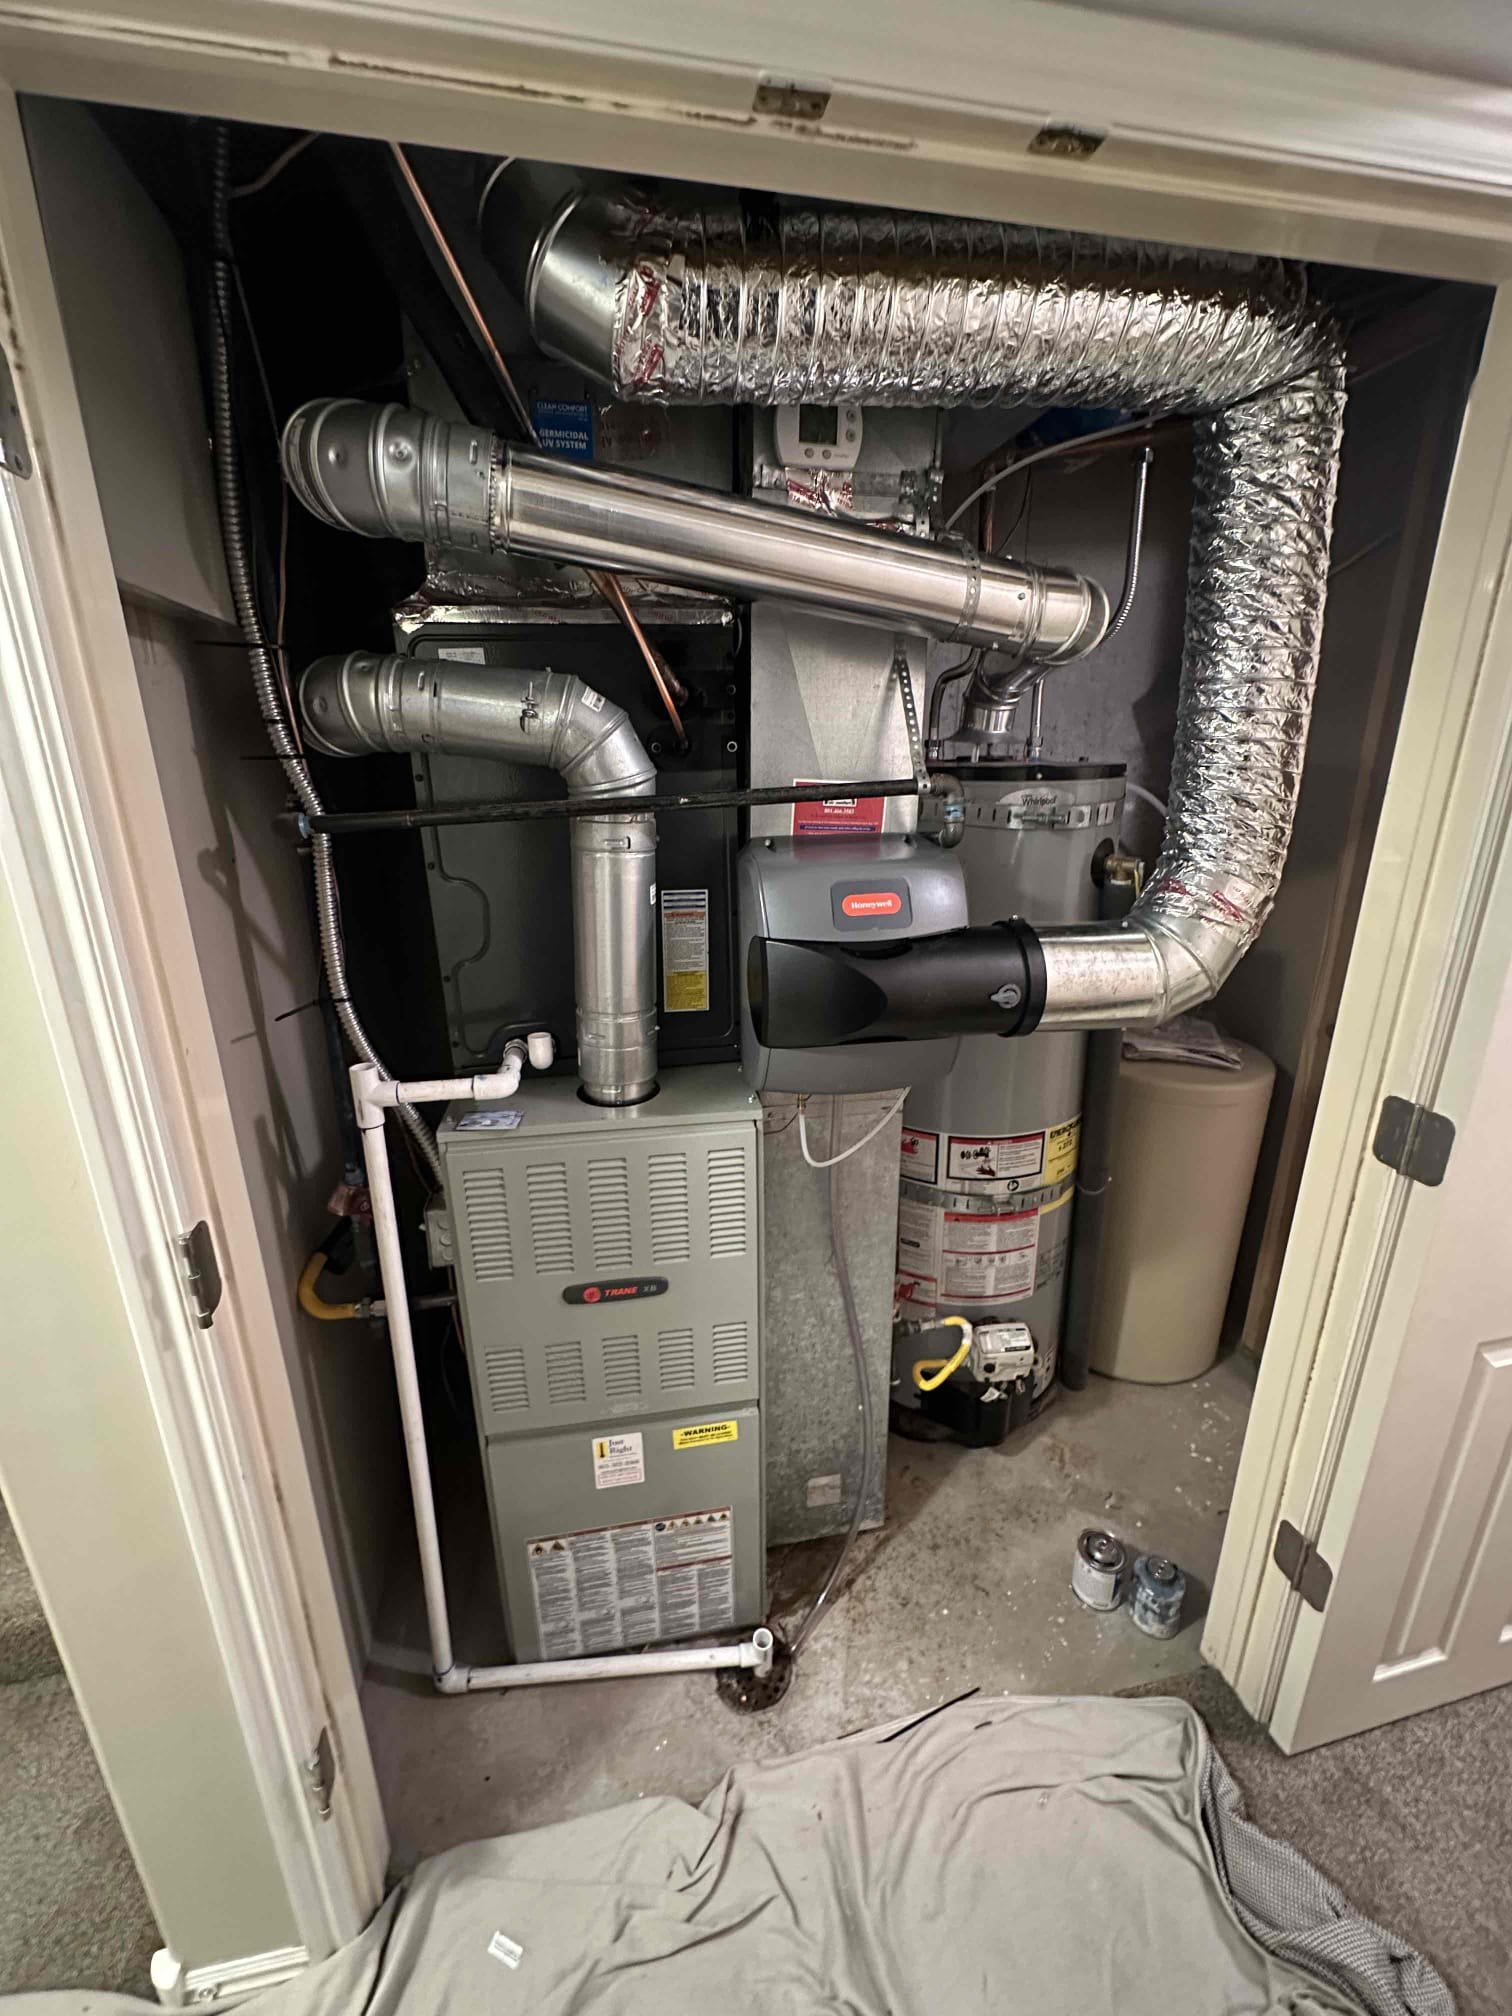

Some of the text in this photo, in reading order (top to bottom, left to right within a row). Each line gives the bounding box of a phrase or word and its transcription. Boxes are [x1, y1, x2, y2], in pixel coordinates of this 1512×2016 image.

[537, 402, 588, 412] CLEAN COMFORT
[539, 428, 589, 440] GERMICIDAL
[542, 439, 587, 449] UV SYSTEM
[1020, 793, 1057, 806] Whirlpool
[851, 899, 892, 910] Honeywell
[605, 1287, 639, 1296] TRANE
[609, 1439, 624, 1448] Just
[610, 1446, 632, 1455] Right
